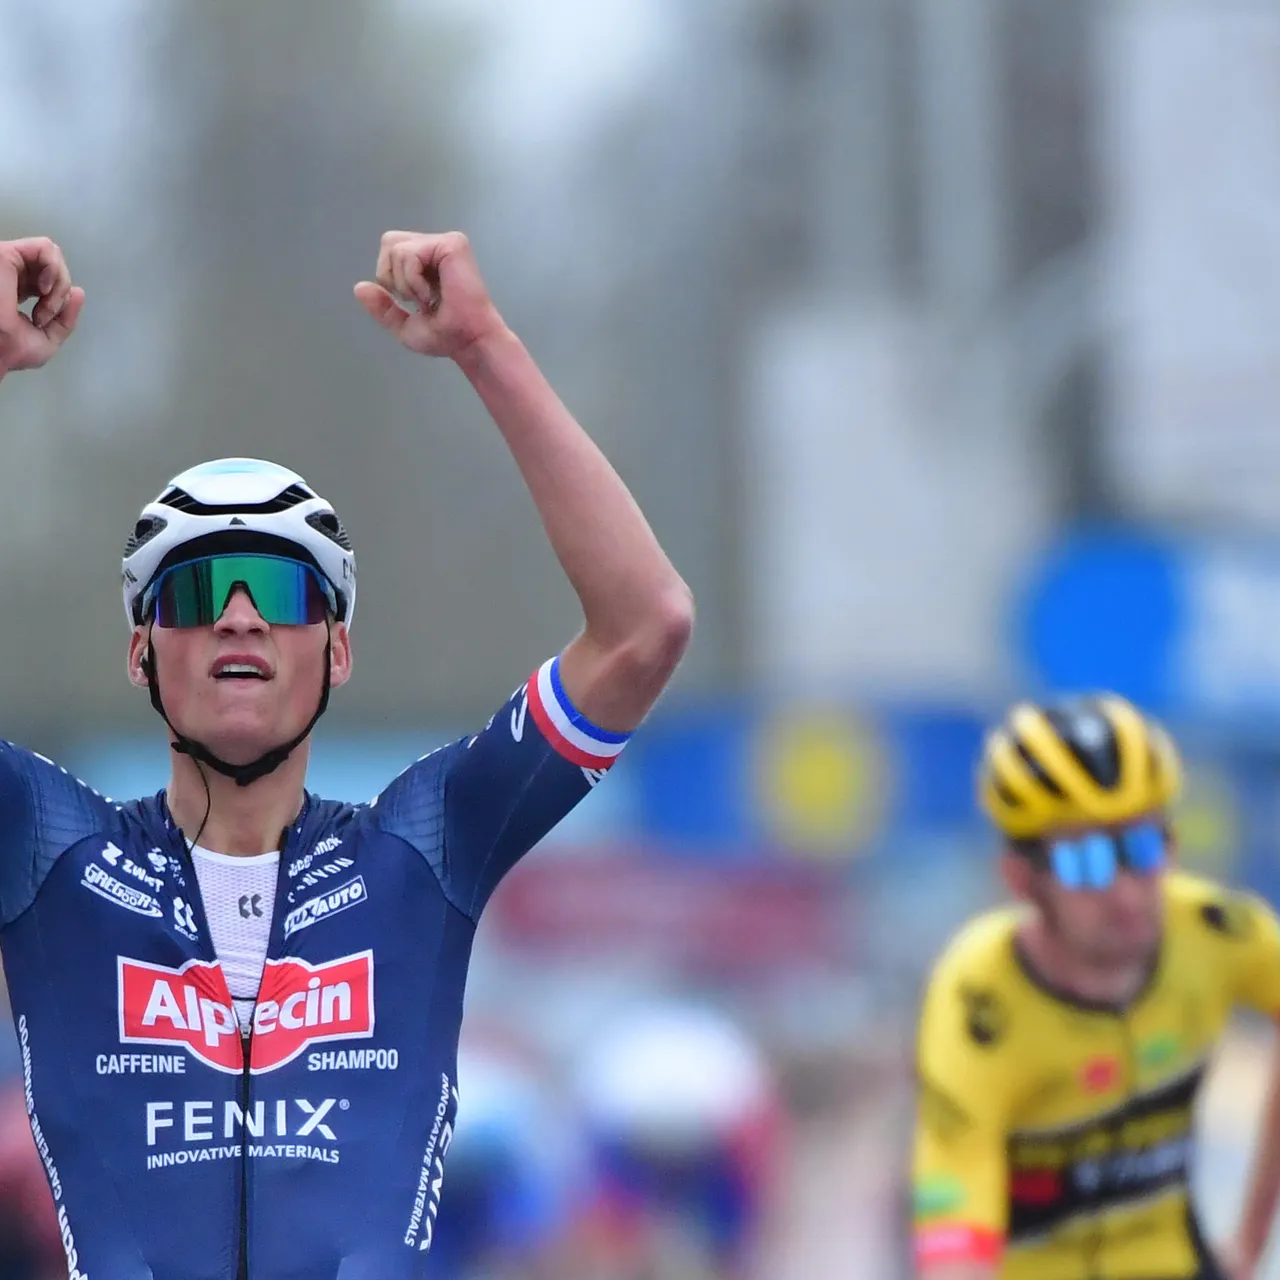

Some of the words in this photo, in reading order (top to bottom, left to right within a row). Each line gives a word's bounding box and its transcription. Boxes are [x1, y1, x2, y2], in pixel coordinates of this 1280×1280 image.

[141, 976, 352, 1048] Alpecin
[95, 1053, 186, 1075] CAFFEINE
[307, 1048, 399, 1071] SHAMPOO
[423, 1071, 450, 1168] INNOVATIVE
[146, 1144, 243, 1171] INNOVATIVE
[247, 1143, 340, 1164] MATERIALS
[404, 1165, 430, 1248] MATERIALS
